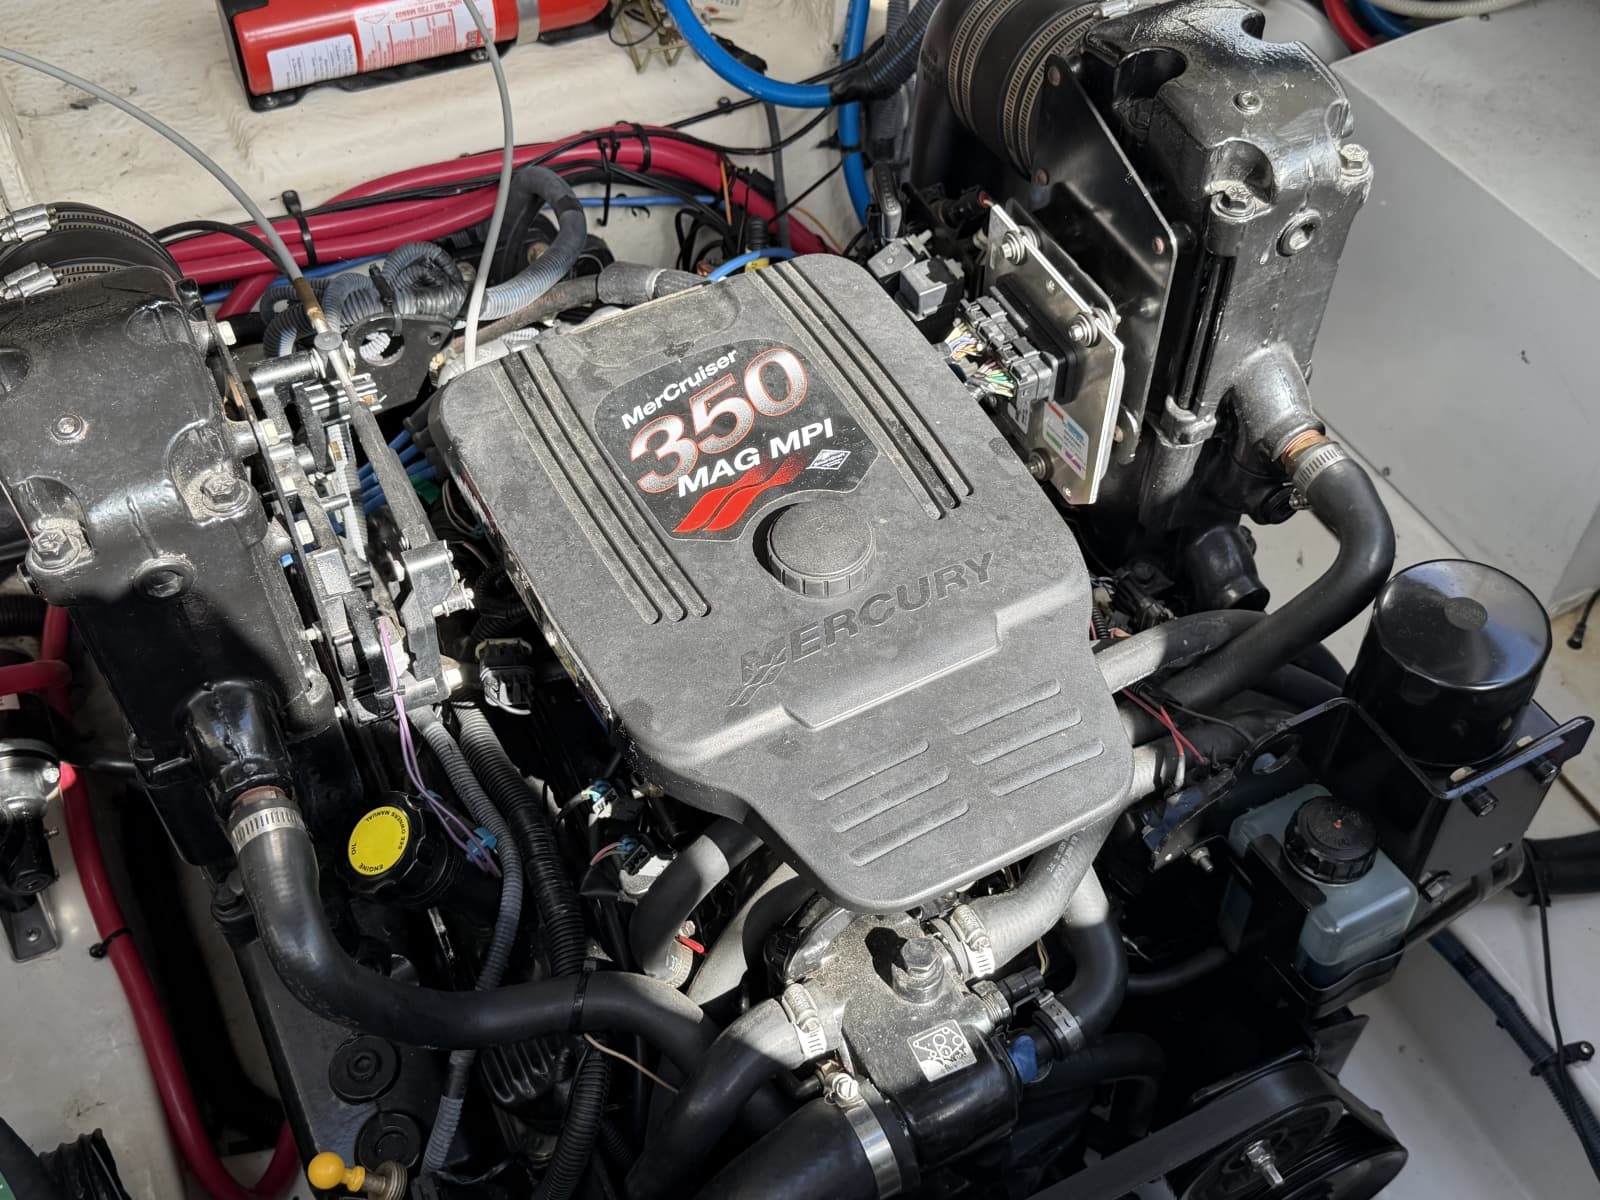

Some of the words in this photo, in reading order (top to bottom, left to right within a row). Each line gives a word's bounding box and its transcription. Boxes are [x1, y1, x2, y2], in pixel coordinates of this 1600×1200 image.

[621, 348, 738, 430] MerCruiser
[630, 348, 808, 493] 350
[677, 447, 761, 498] MAG
[769, 418, 834, 459] MPI
[725, 552, 994, 707] MERCURY
[365, 810, 390, 822] MANUAL
[359, 862, 384, 872] ENGINE
